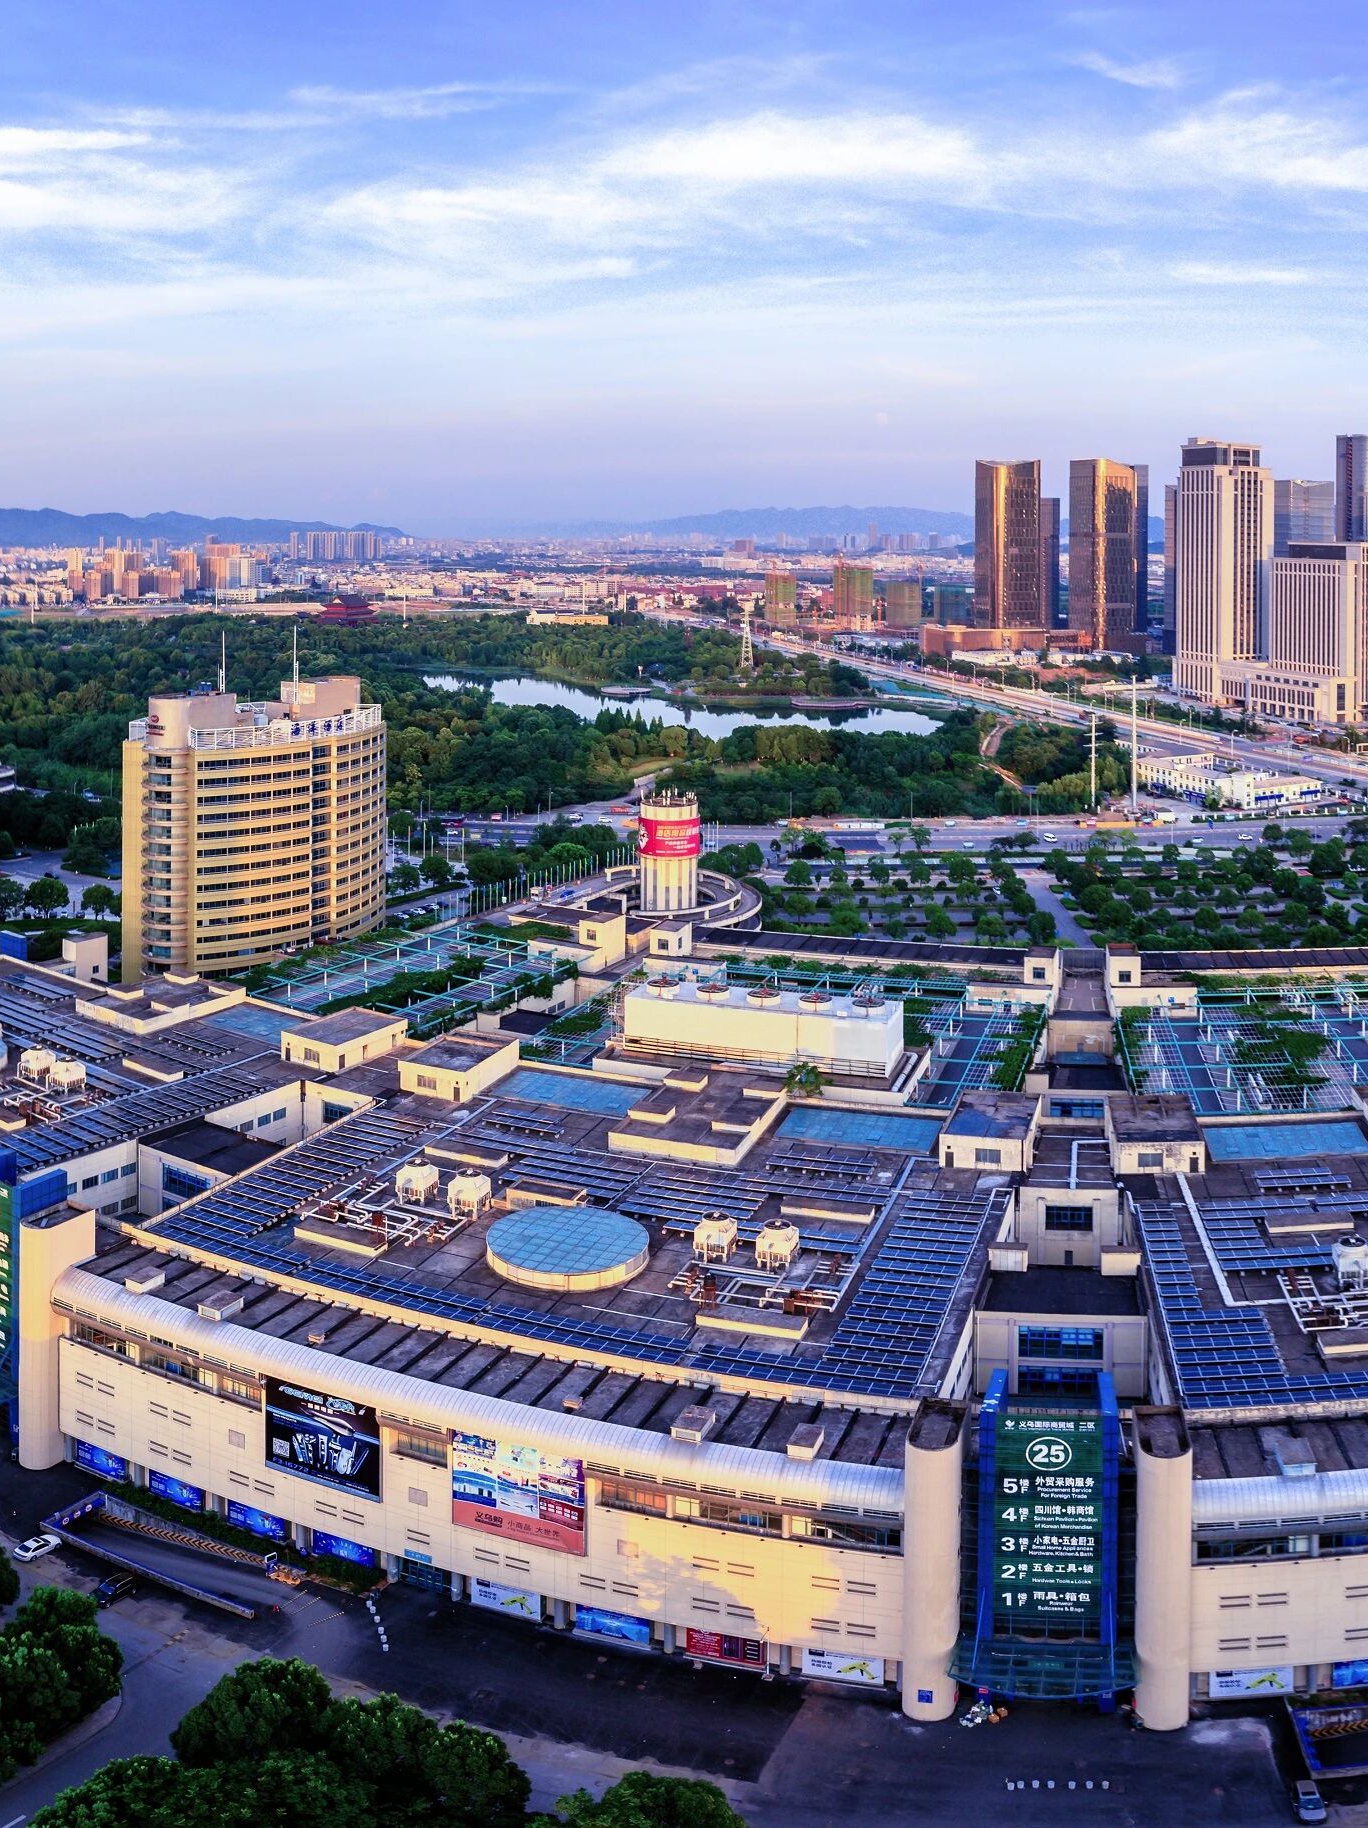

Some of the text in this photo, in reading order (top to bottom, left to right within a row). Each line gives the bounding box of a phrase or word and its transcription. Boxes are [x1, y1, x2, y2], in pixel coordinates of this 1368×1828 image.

[1033, 1444, 1066, 1463] 25
[1003, 1478, 1018, 1494] 5
[1035, 1476, 1095, 1487] 外贸采购服务
[1001, 1507, 1017, 1522] 4
[1001, 1537, 1015, 1552] 3
[1001, 1564, 1016, 1579] 2
[1002, 1592, 1012, 1606] 1
